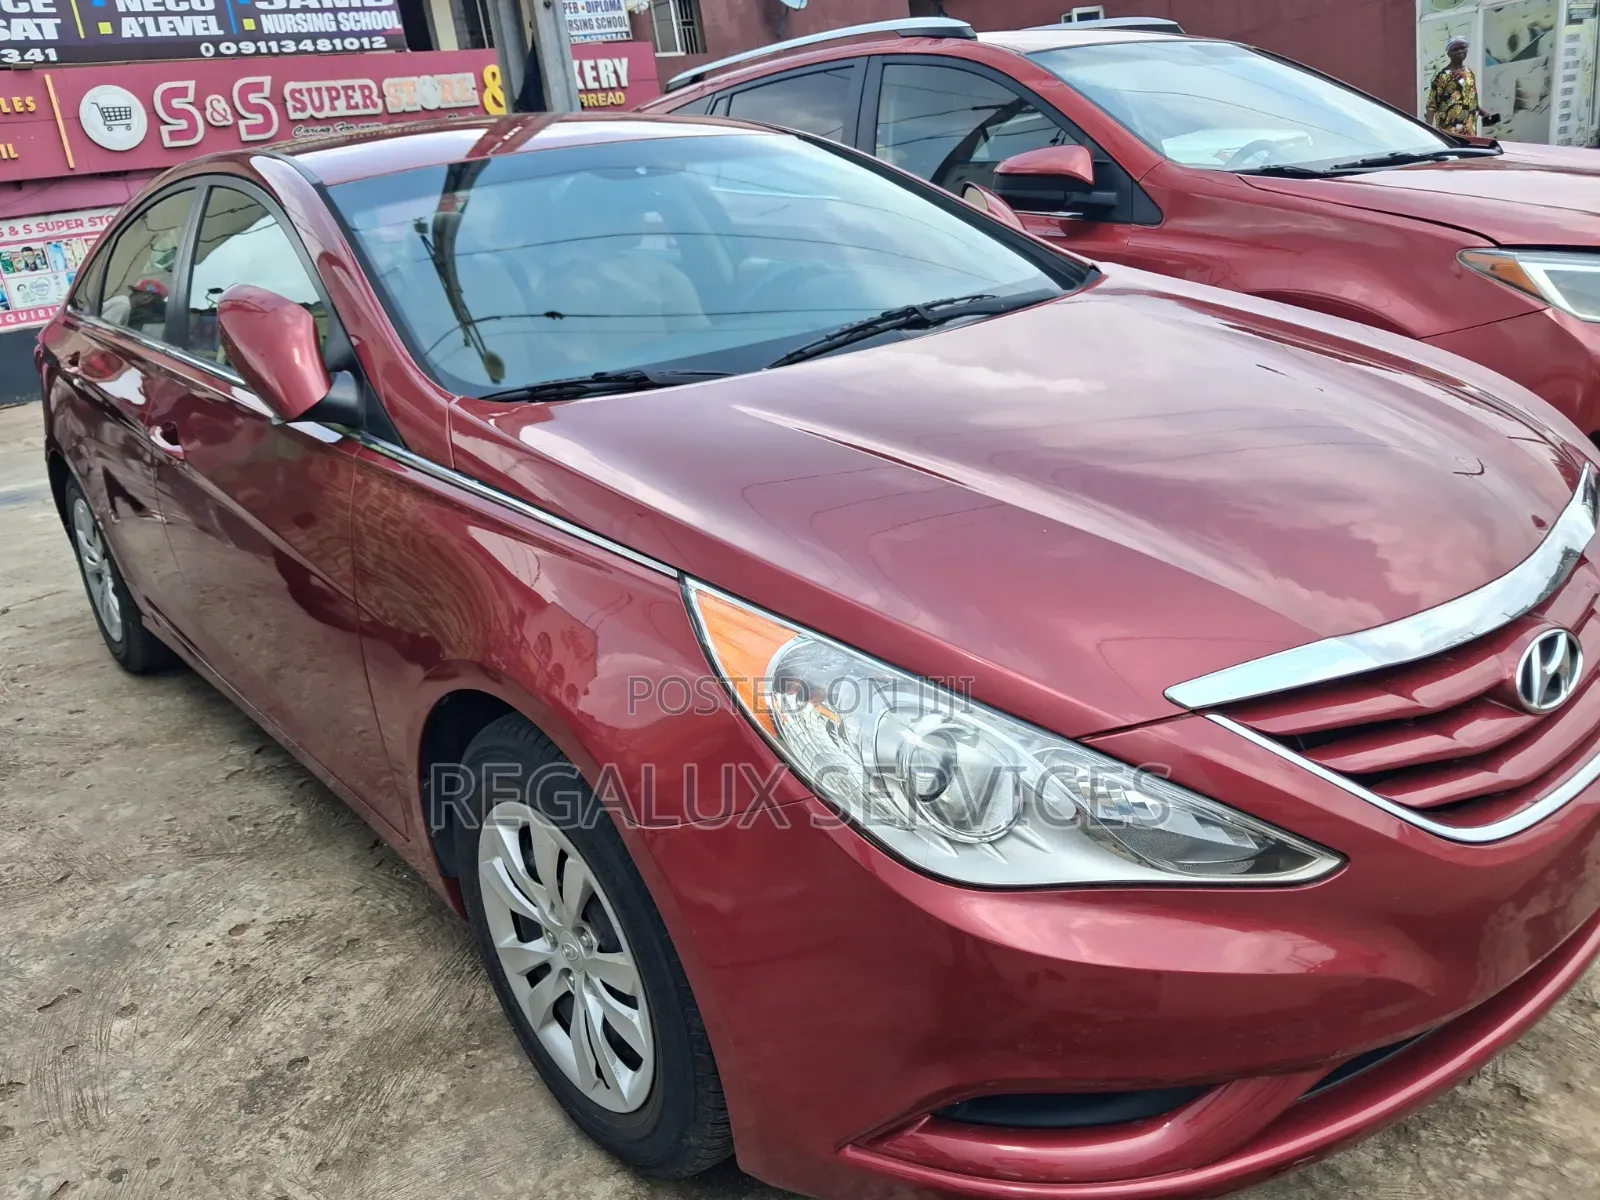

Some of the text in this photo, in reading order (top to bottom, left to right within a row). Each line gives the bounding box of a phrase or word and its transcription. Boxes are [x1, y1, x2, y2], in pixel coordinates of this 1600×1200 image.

[585, 0, 623, 13] DIPLOMA
[260, 10, 402, 34] NURSING SCHOOL
[595, 16, 628, 29] SCHOOL
[286, 80, 382, 118] SUPER
[383, 73, 479, 112] STORE
[579, 91, 625, 107] BREAD
[8, 226, 19, 236] &
[22, 224, 32, 235] S
[36, 219, 84, 233] SUPER
